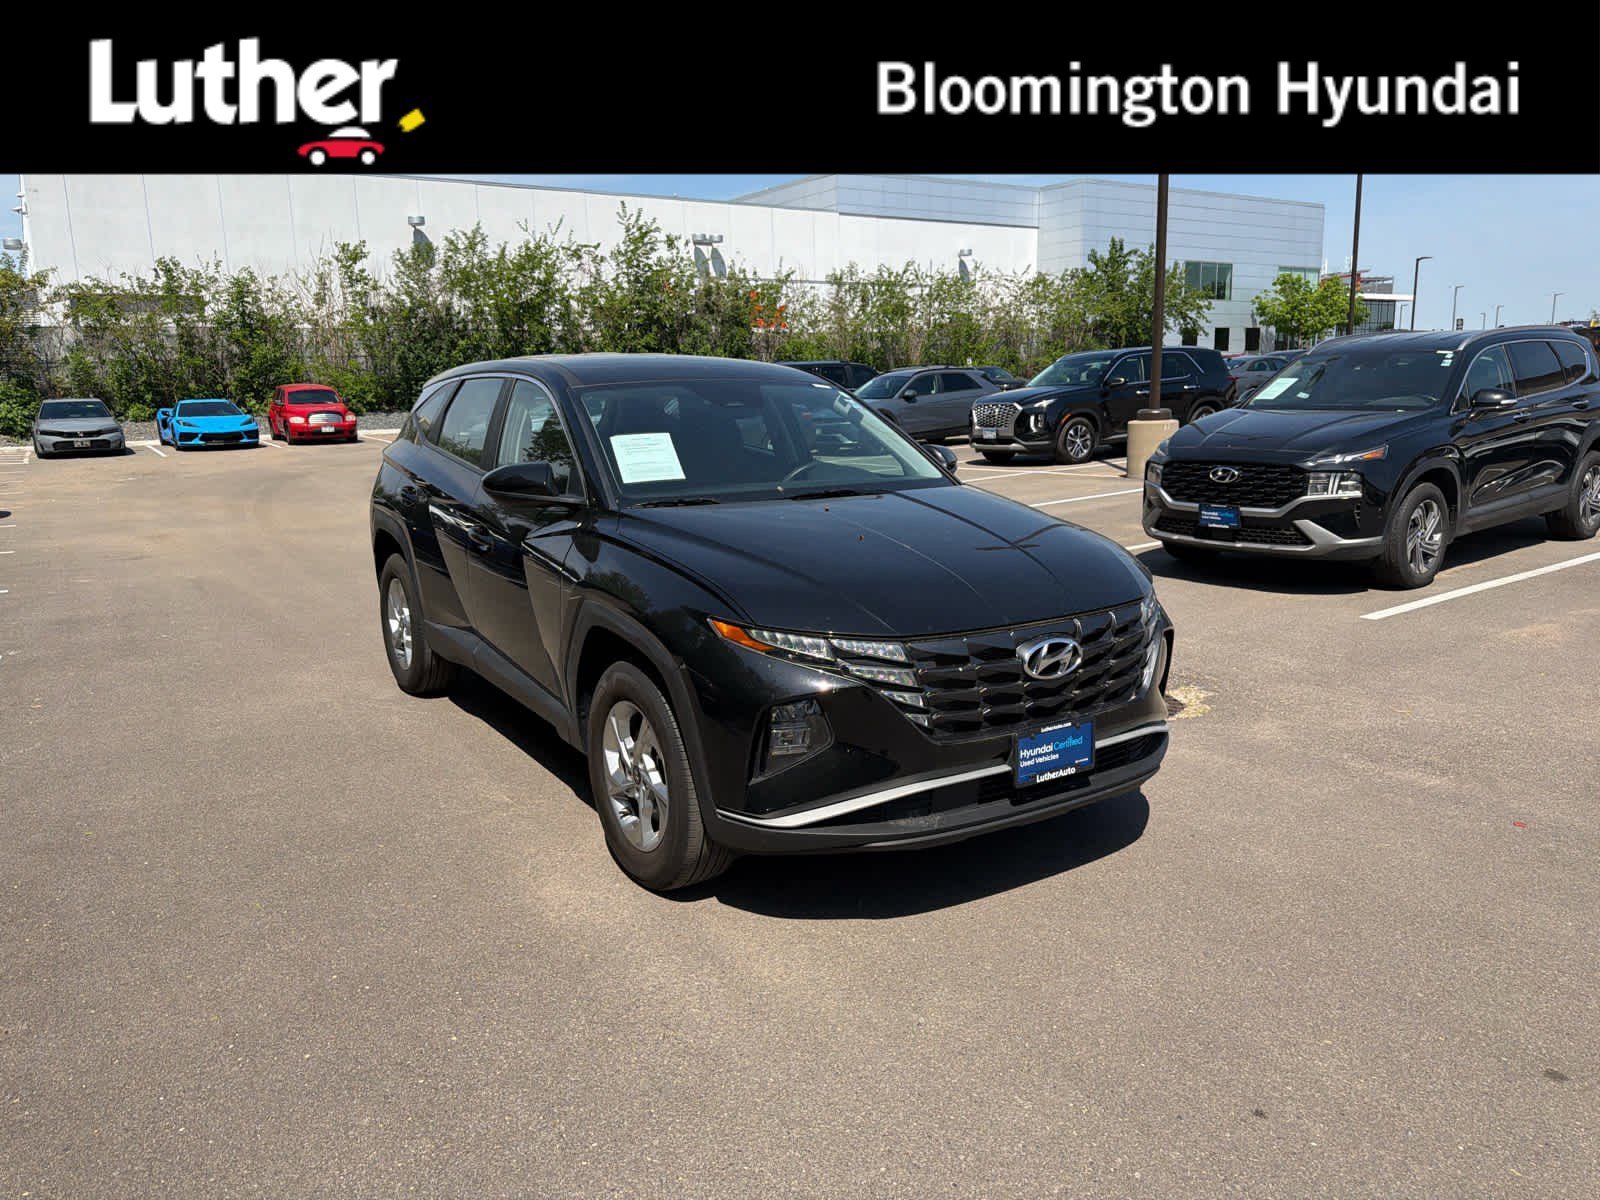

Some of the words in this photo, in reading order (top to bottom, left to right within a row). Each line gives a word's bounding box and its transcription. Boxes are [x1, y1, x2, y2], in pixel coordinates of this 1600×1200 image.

[1020, 742, 1053, 758] Hyundai
[1053, 735, 1083, 750] Certified
[1020, 759, 1035, 768] Used
[1036, 754, 1059, 765] Vehicles
[1036, 767, 1076, 783] LutherAuto
